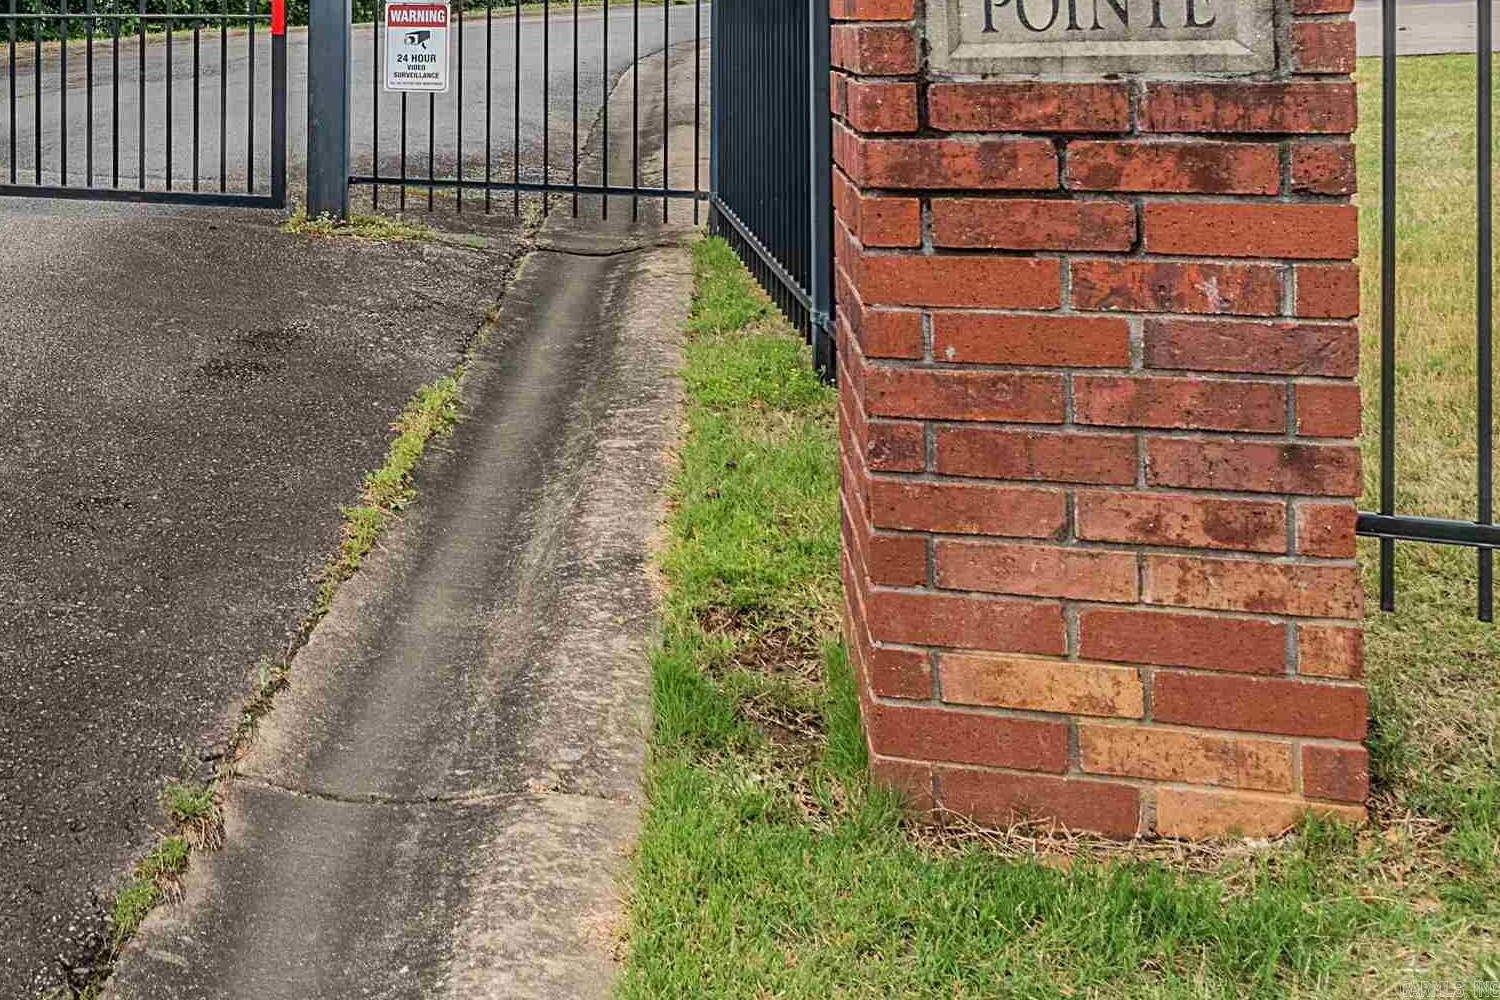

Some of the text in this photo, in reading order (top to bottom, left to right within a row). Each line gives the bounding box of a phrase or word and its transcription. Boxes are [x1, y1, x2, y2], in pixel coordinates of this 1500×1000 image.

[390, 9, 445, 23] WARNING
[397, 54, 436, 63] 24 HOUR
